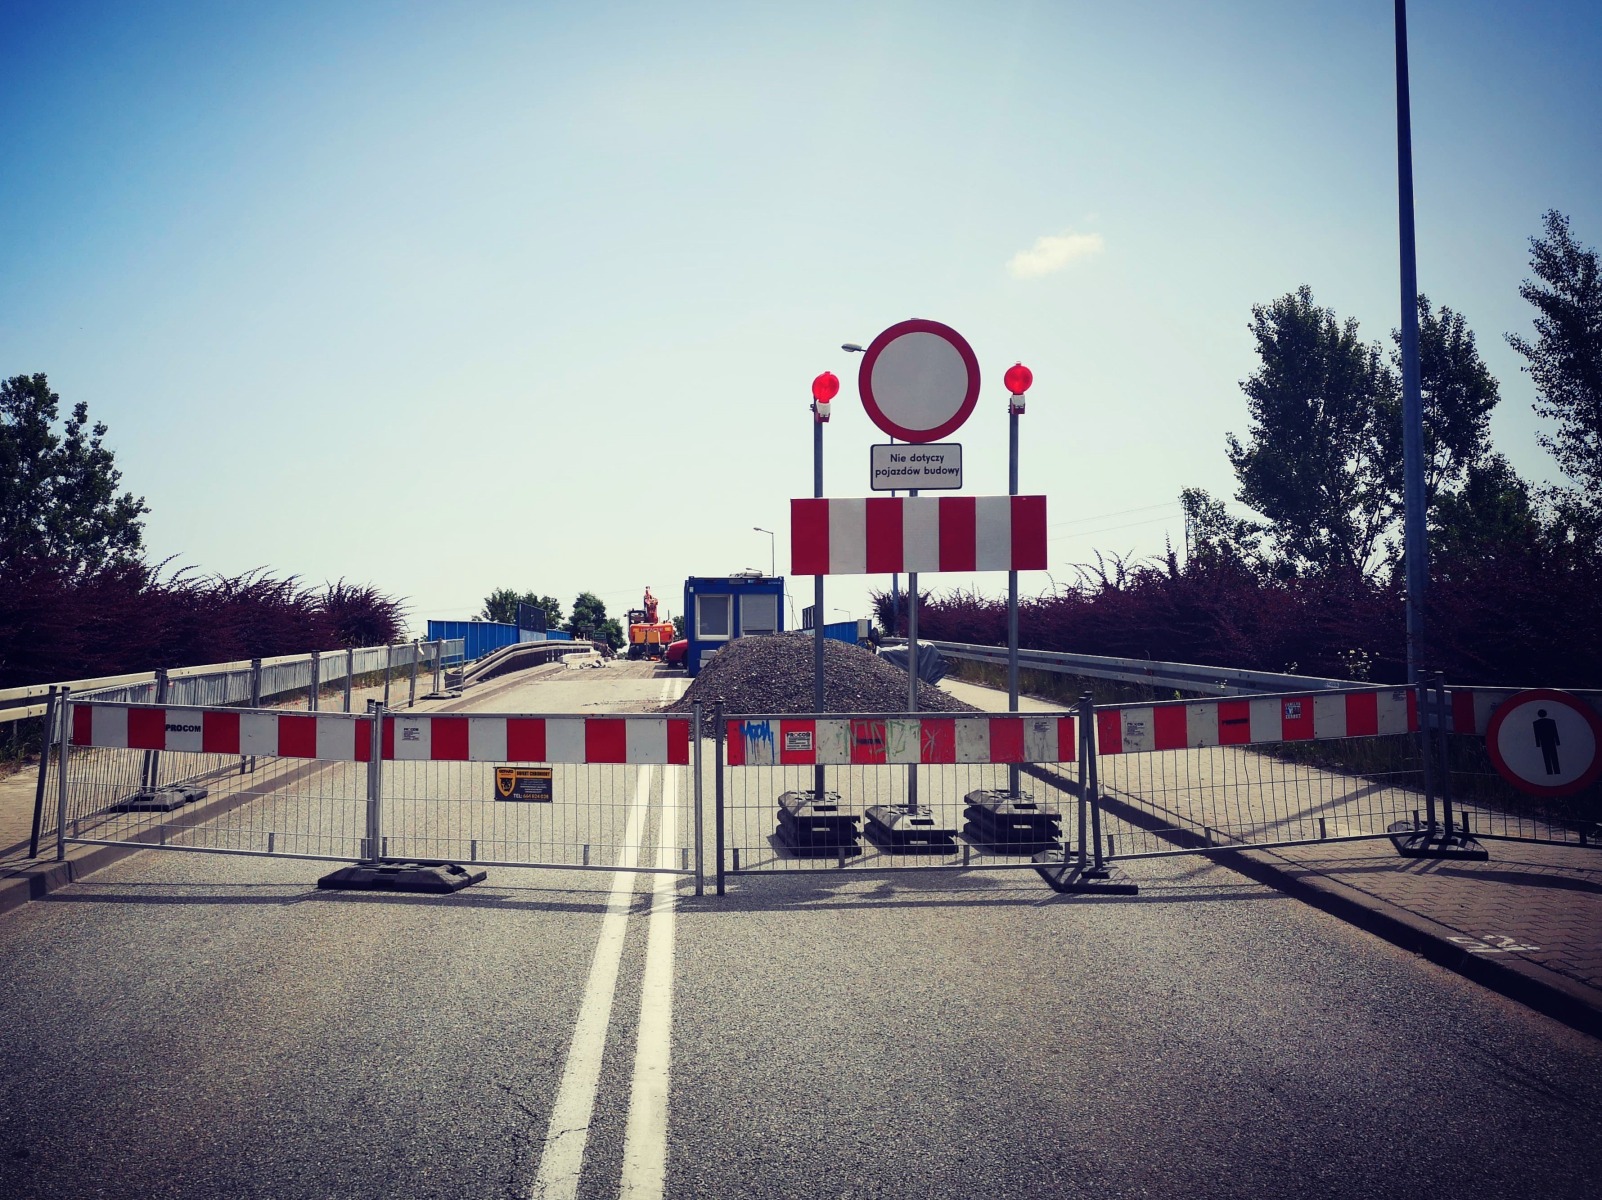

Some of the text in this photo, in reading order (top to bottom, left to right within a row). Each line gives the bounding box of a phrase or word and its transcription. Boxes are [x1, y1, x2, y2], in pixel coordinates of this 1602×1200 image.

[890, 453, 944, 464] Nie dotyczy
[875, 466, 960, 478] pojazdów budowy
[165, 723, 202, 732] PROCOM
